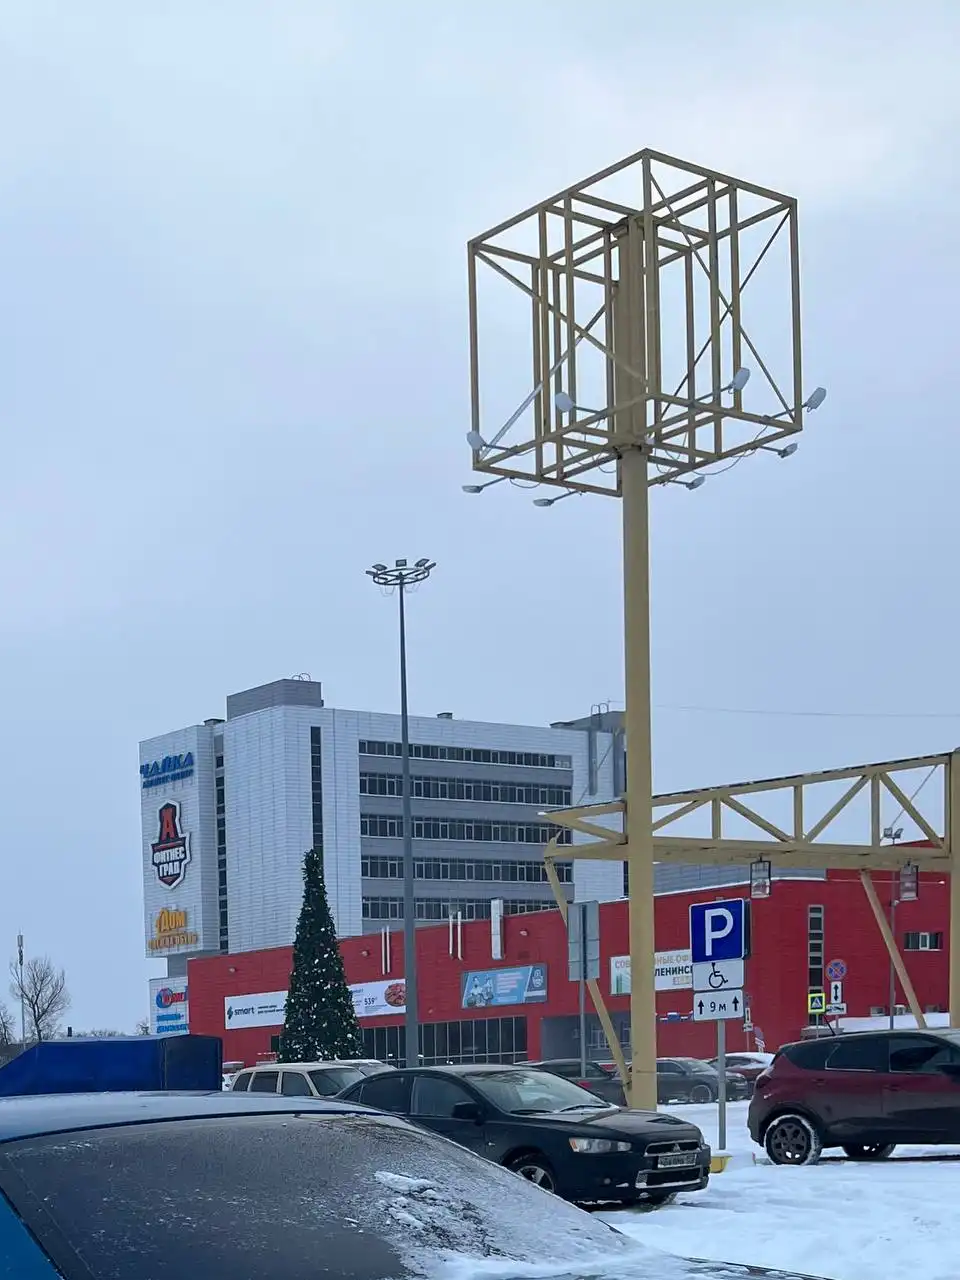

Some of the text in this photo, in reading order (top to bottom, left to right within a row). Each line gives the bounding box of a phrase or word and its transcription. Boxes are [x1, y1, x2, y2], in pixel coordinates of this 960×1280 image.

[140, 752, 194, 778] ЧАЙКА
[153, 846, 185, 864] ФИТНЕС
[159, 861, 180, 877] ГРАД
[705, 908, 734, 956] P
[654, 965, 693, 977] ЛЕНИНС
[234, 1006, 255, 1016] smart
[710, 1002, 716, 1013] 9
